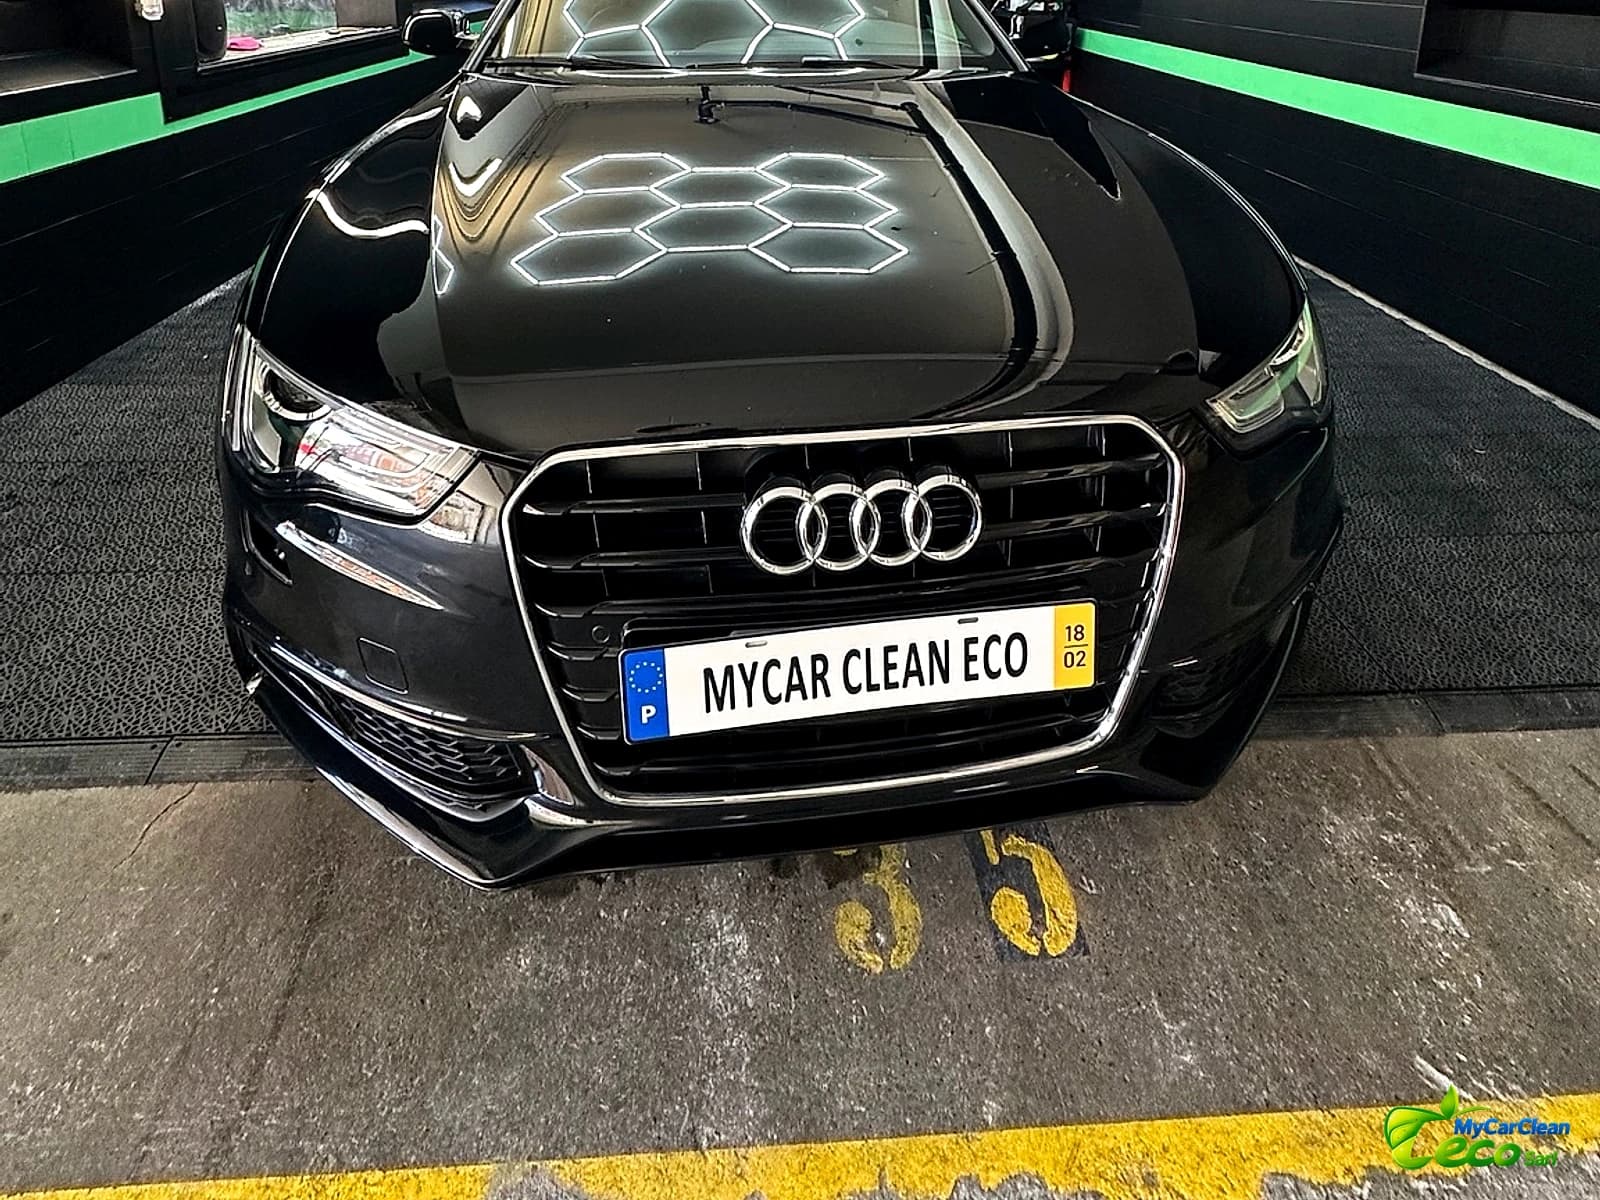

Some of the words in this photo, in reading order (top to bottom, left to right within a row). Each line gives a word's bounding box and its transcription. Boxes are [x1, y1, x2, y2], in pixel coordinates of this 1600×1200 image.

[1065, 624, 1085, 642] 18
[1063, 650, 1087, 669] 02
[703, 652, 831, 714] MYCAR
[842, 639, 951, 695] CLEAN
[963, 631, 1029, 682] ECO
[641, 704, 657, 725] P
